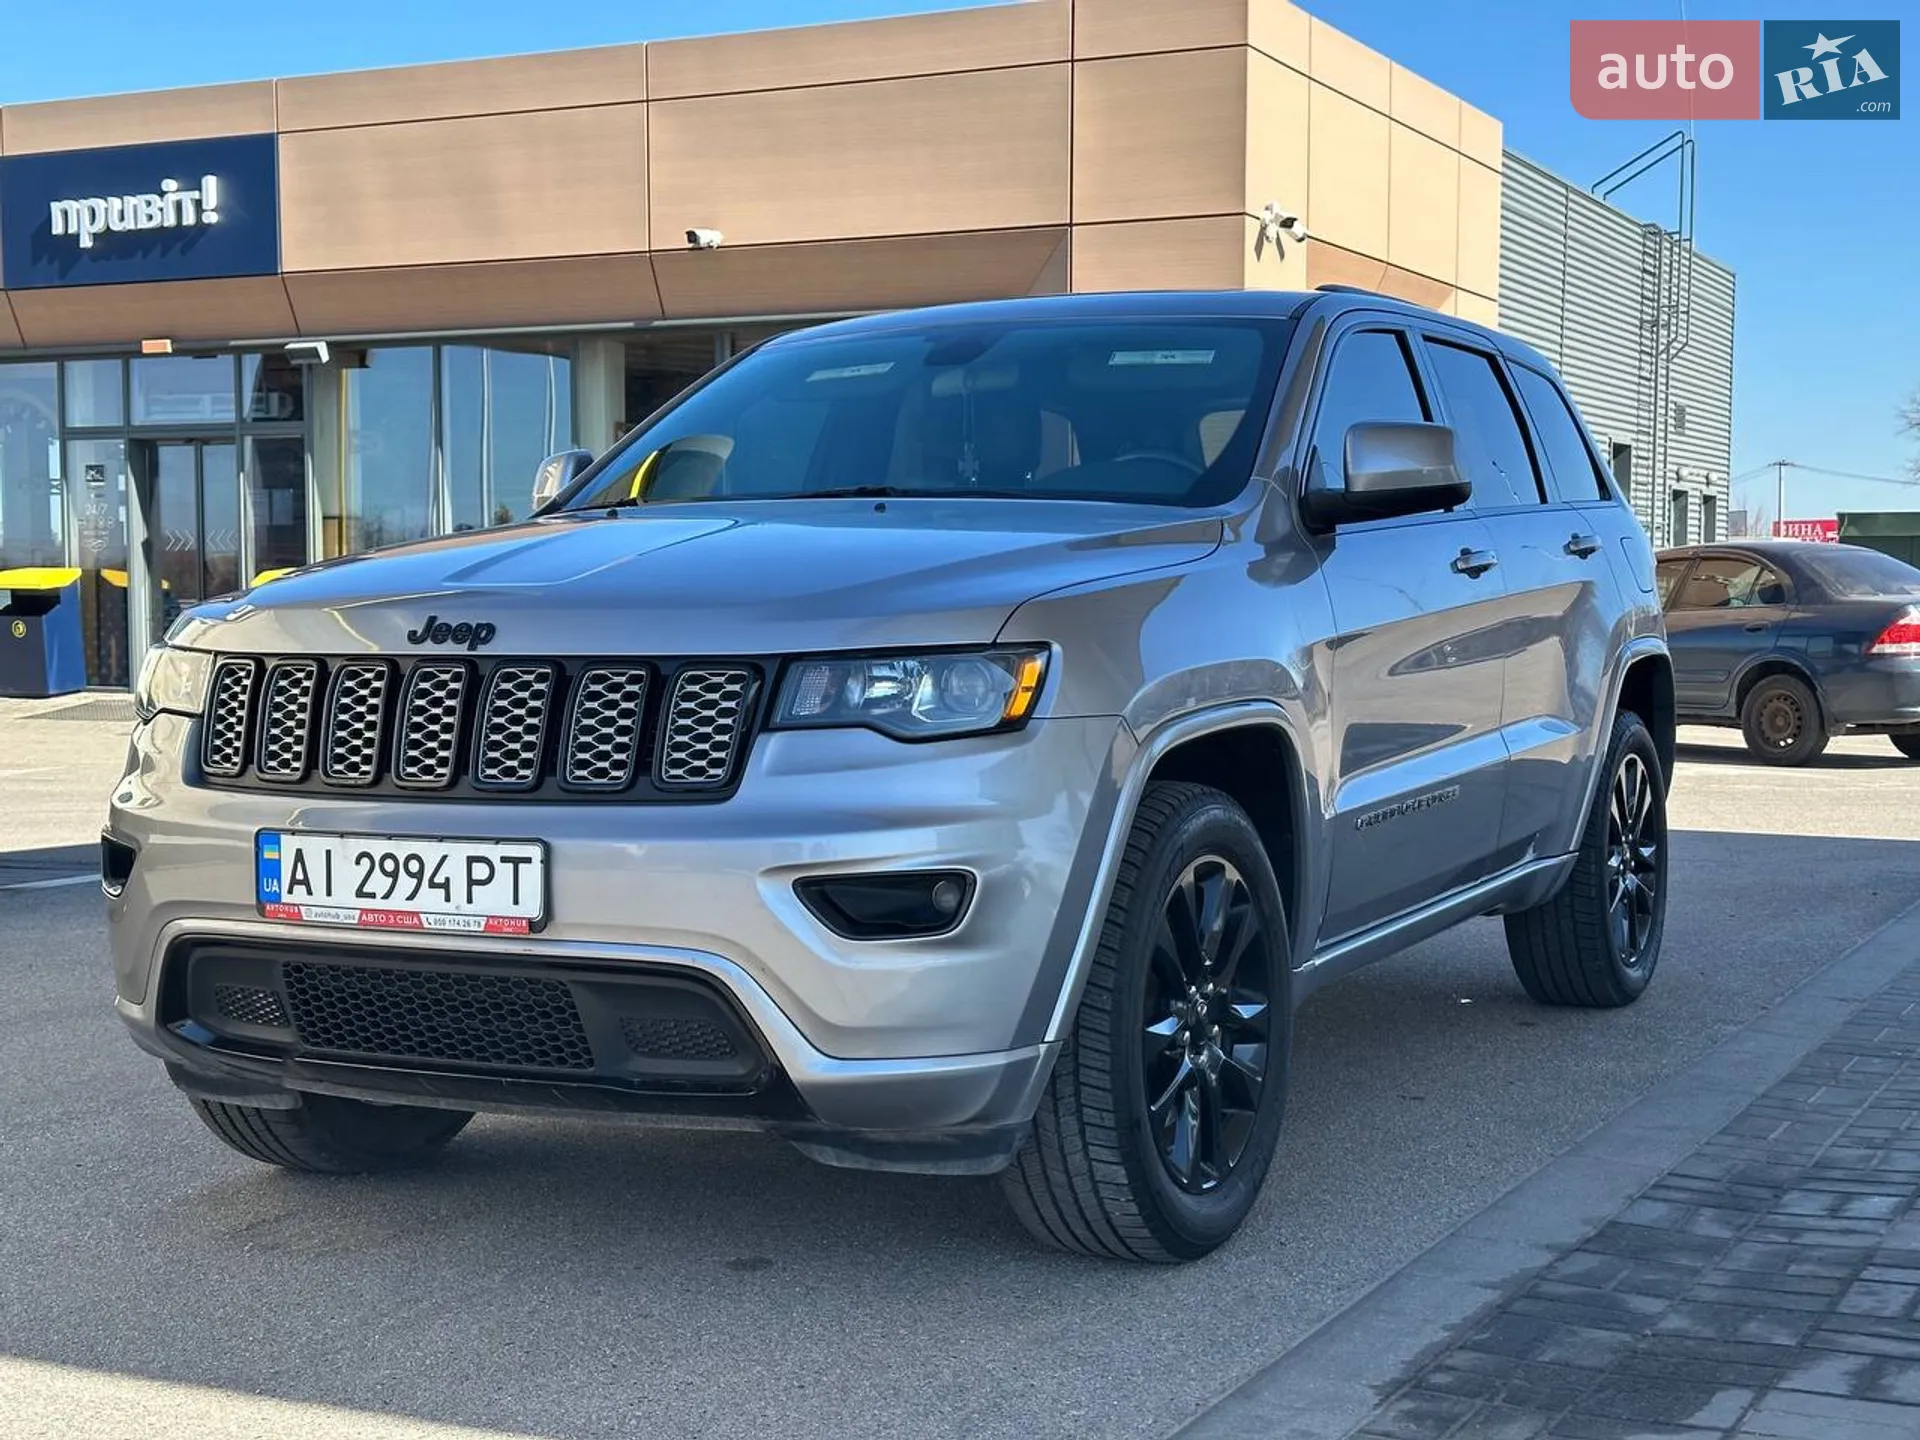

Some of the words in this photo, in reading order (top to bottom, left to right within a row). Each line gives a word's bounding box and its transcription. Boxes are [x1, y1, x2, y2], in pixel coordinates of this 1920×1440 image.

[50, 174, 219, 248] привіт!
[407, 615, 497, 652] Jeep
[263, 877, 280, 893] UA
[286, 848, 333, 898] AI
[354, 851, 451, 903] 2994
[466, 855, 533, 906] PT
